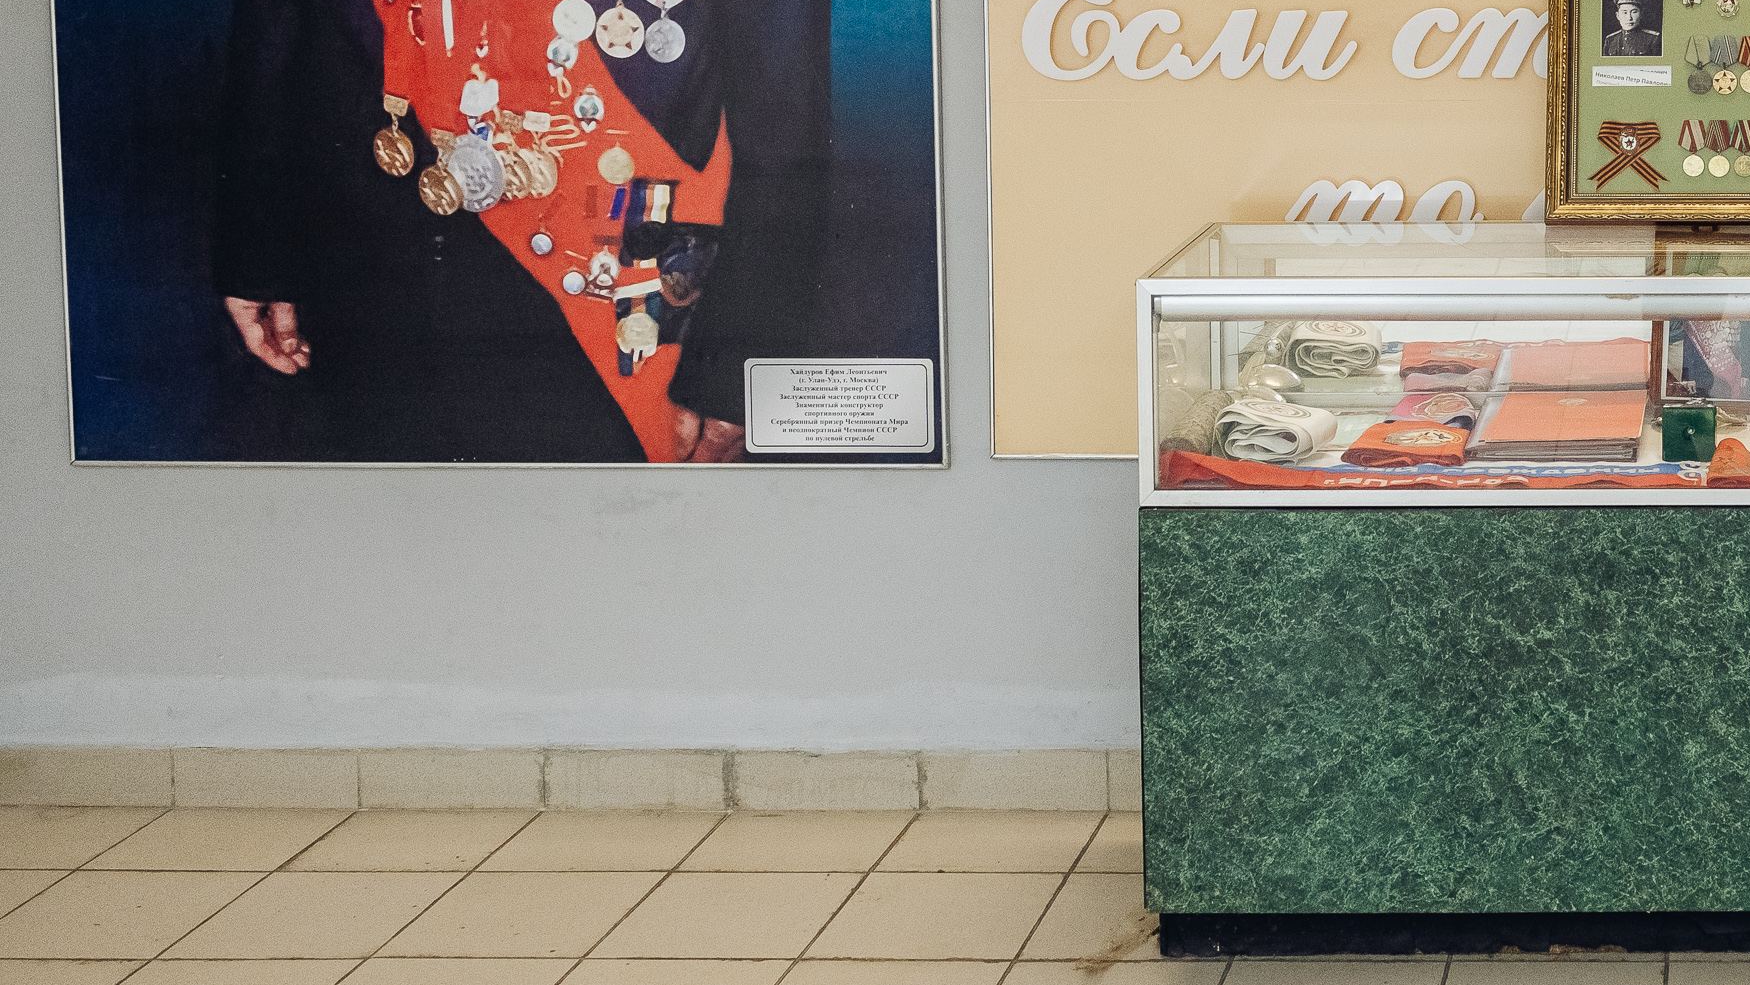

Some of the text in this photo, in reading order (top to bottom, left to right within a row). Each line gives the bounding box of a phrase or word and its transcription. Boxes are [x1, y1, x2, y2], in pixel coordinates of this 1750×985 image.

[1594, 71, 1625, 81] Николаев
[1625, 75, 1641, 84] Петр
[825, 368, 845, 376] Ефим
[791, 385, 839, 393] Заслуженный
[779, 393, 826, 401] Заслуженный
[888, 418, 909, 426] Мира
[844, 435, 875, 443] стрельбе
